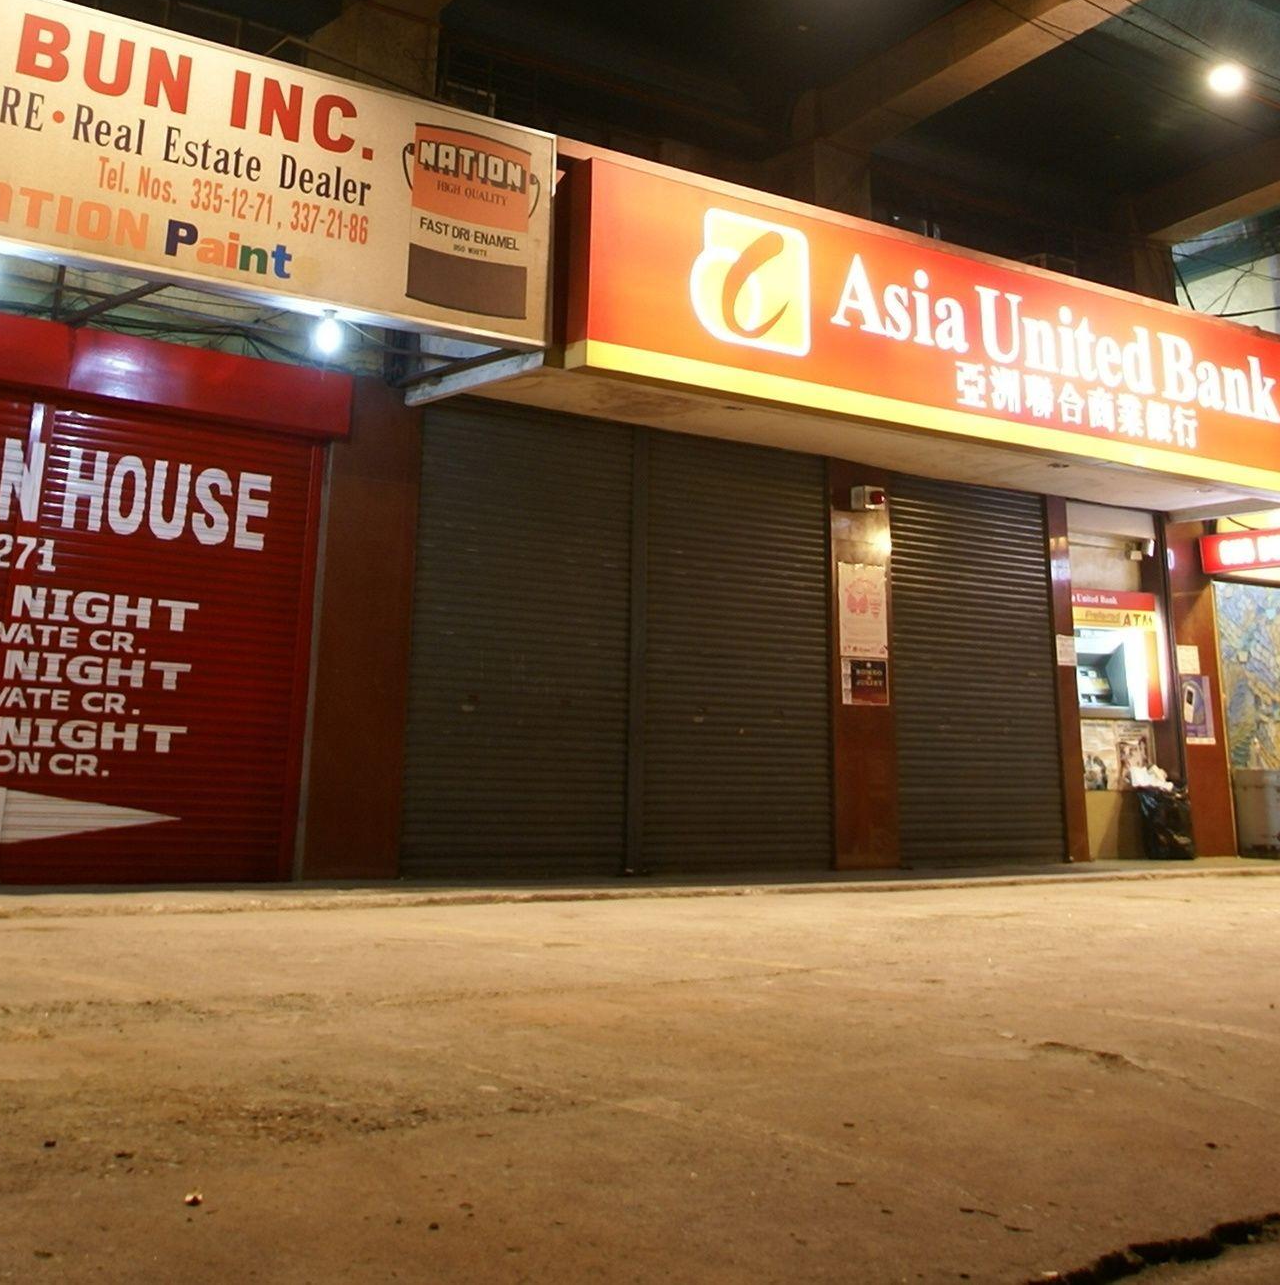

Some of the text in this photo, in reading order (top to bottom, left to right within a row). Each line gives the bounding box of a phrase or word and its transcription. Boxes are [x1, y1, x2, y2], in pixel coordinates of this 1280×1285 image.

[15, 13, 194, 115] BUN
[230, 70, 377, 161] INC.
[72, 104, 147, 157] Real
[162, 126, 263, 183] Estate
[278, 153, 373, 209] Dealer
[419, 138, 527, 195] NATION
[98, 156, 131, 193] Tel.
[137, 166, 178, 206] Nos.
[290, 200, 370, 246] 337-21-86
[436, 180, 510, 207] HIGH QUALITY
[164, 218, 293, 280] Paint
[419, 216, 450, 237] FAST
[829, 252, 969, 353] Asia
[973, 283, 1156, 397] United
[60, 443, 274, 552] HOUSE
[11, 583, 200, 634] NIGHT
[2, 647, 192, 692] NIGHT
[88, 629, 147, 656] CR.
[80, 690, 141, 716] CR.
[47, 751, 111, 778] CR.
